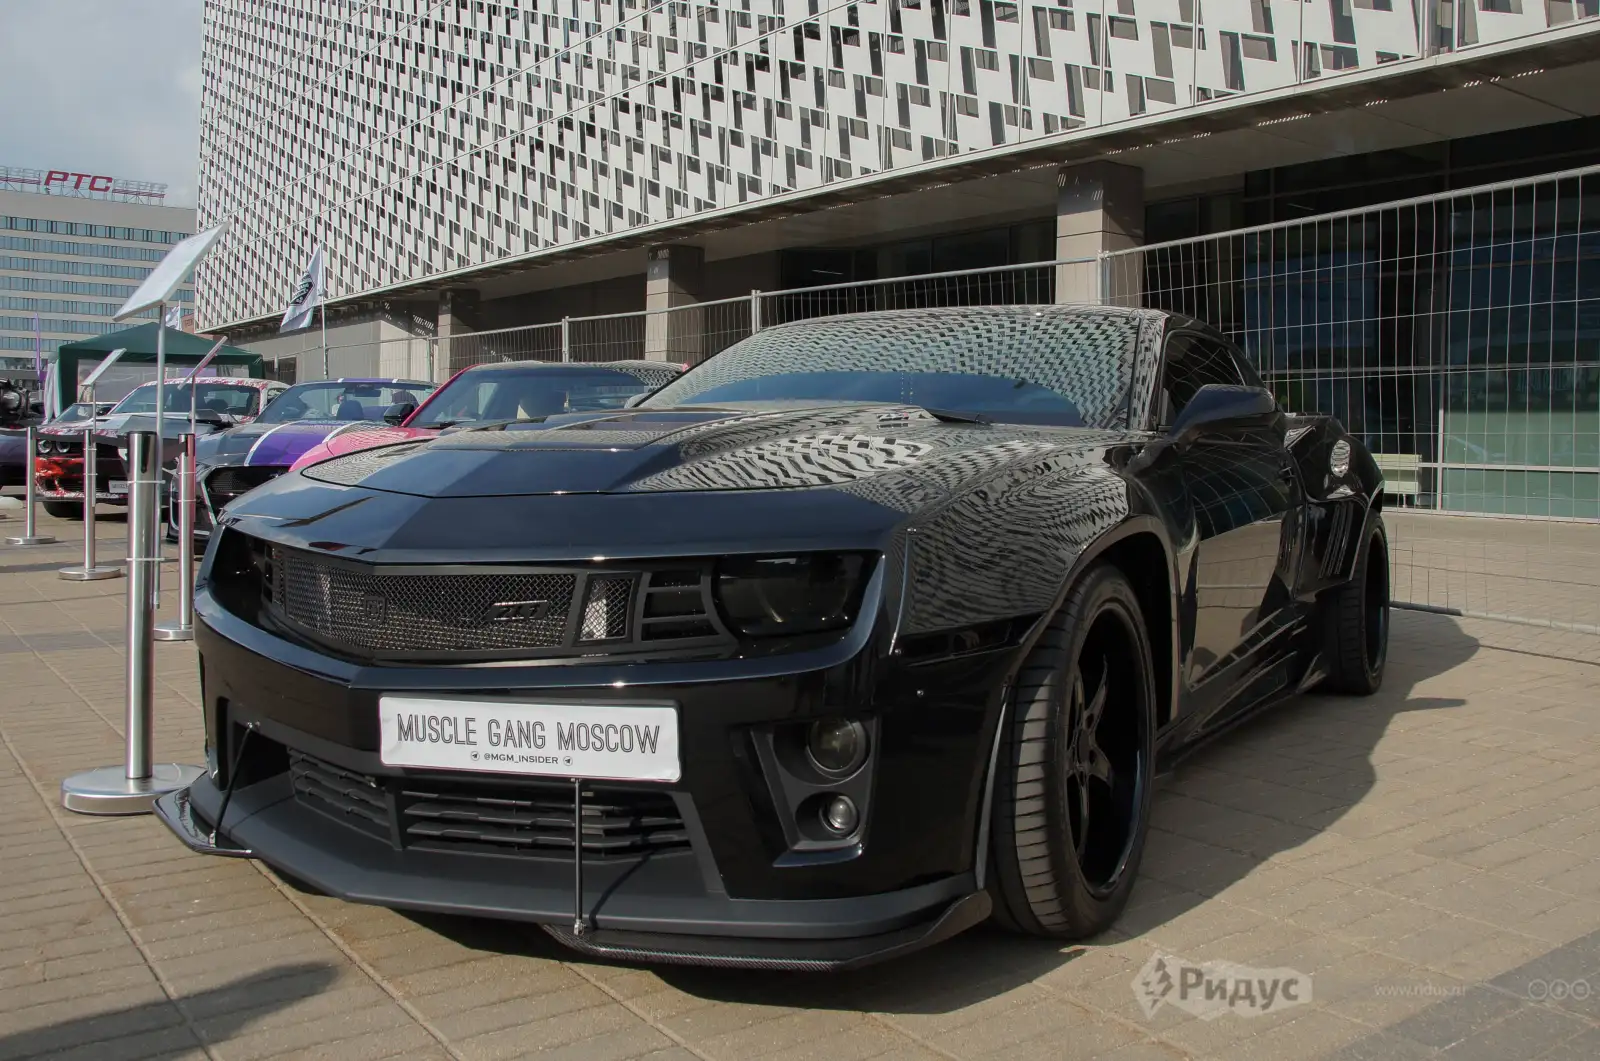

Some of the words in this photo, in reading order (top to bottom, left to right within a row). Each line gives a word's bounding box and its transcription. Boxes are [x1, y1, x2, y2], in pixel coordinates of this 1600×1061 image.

[44, 170, 113, 193] РТС
[397, 713, 478, 746] MUSCLE
[487, 718, 546, 749] GANG
[556, 722, 660, 754] MOSCOW
[483, 752, 559, 765] @MGM_INSIDER
